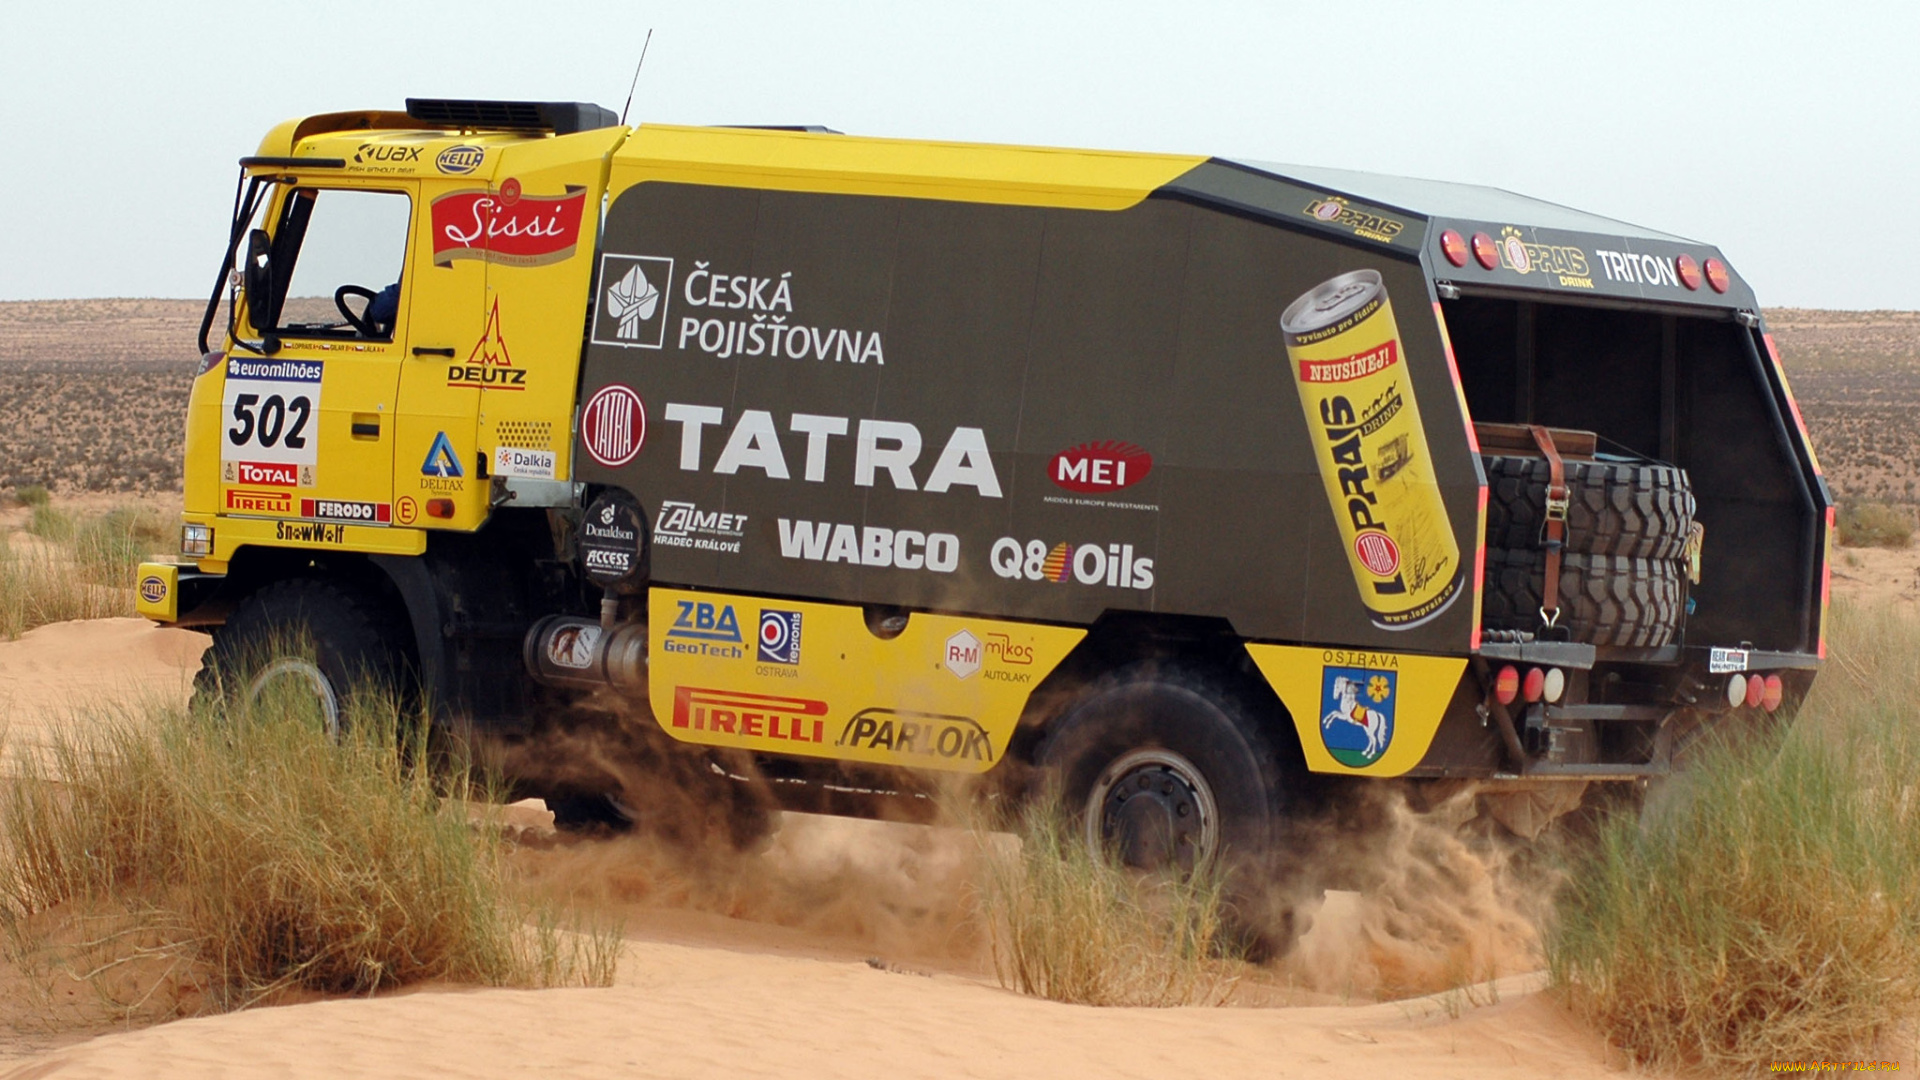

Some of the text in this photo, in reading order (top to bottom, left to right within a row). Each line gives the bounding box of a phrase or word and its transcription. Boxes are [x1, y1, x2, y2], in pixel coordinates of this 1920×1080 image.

[439, 152, 485, 167] HELLA
[445, 198, 565, 248] Sissi
[1354, 228, 1392, 243] DRINK
[1596, 249, 1679, 287] TRITON
[684, 260, 792, 312] ČESKÁ
[1559, 275, 1595, 288] DRINK
[1337, 318, 1353, 332] pro
[679, 313, 884, 365] POJIŠŤOVNA
[240, 362, 321, 379] euromilhões
[1309, 347, 1390, 381] NEUSÍNEJ!
[448, 366, 527, 384] DEUTZ
[229, 394, 311, 449] 502
[595, 392, 632, 459] TATRA
[1362, 401, 1400, 436] DRINK
[665, 403, 1003, 498] TATRA
[514, 453, 552, 468] Dalkia
[240, 465, 296, 483] TOTAL
[1058, 456, 1126, 486] MEI
[420, 478, 464, 491] DELTAX
[227, 489, 292, 512] PIRELLI
[1043, 496, 1159, 511] MIDDLE EUROPE INVESTMENTS
[318, 502, 373, 518] FERODO
[586, 523, 634, 540] Donaldson
[653, 535, 693, 548] HRADEC
[694, 538, 741, 553] KRÁLOVÉ
[778, 518, 960, 572] WABCO
[586, 550, 629, 566] ACCESS
[141, 584, 167, 596] HELLA
[668, 600, 743, 640] ZBA
[790, 613, 801, 664] repronis
[664, 640, 742, 658] GeoTech
[949, 646, 978, 663] R-M
[985, 633, 1034, 665] mikos
[1323, 650, 1399, 668] OSTRAVA
[755, 666, 799, 678] OSTRAVA
[983, 670, 1032, 683] AUTOLAKY
[672, 685, 829, 743] PIRELLI
[849, 716, 990, 760] PARLOK
